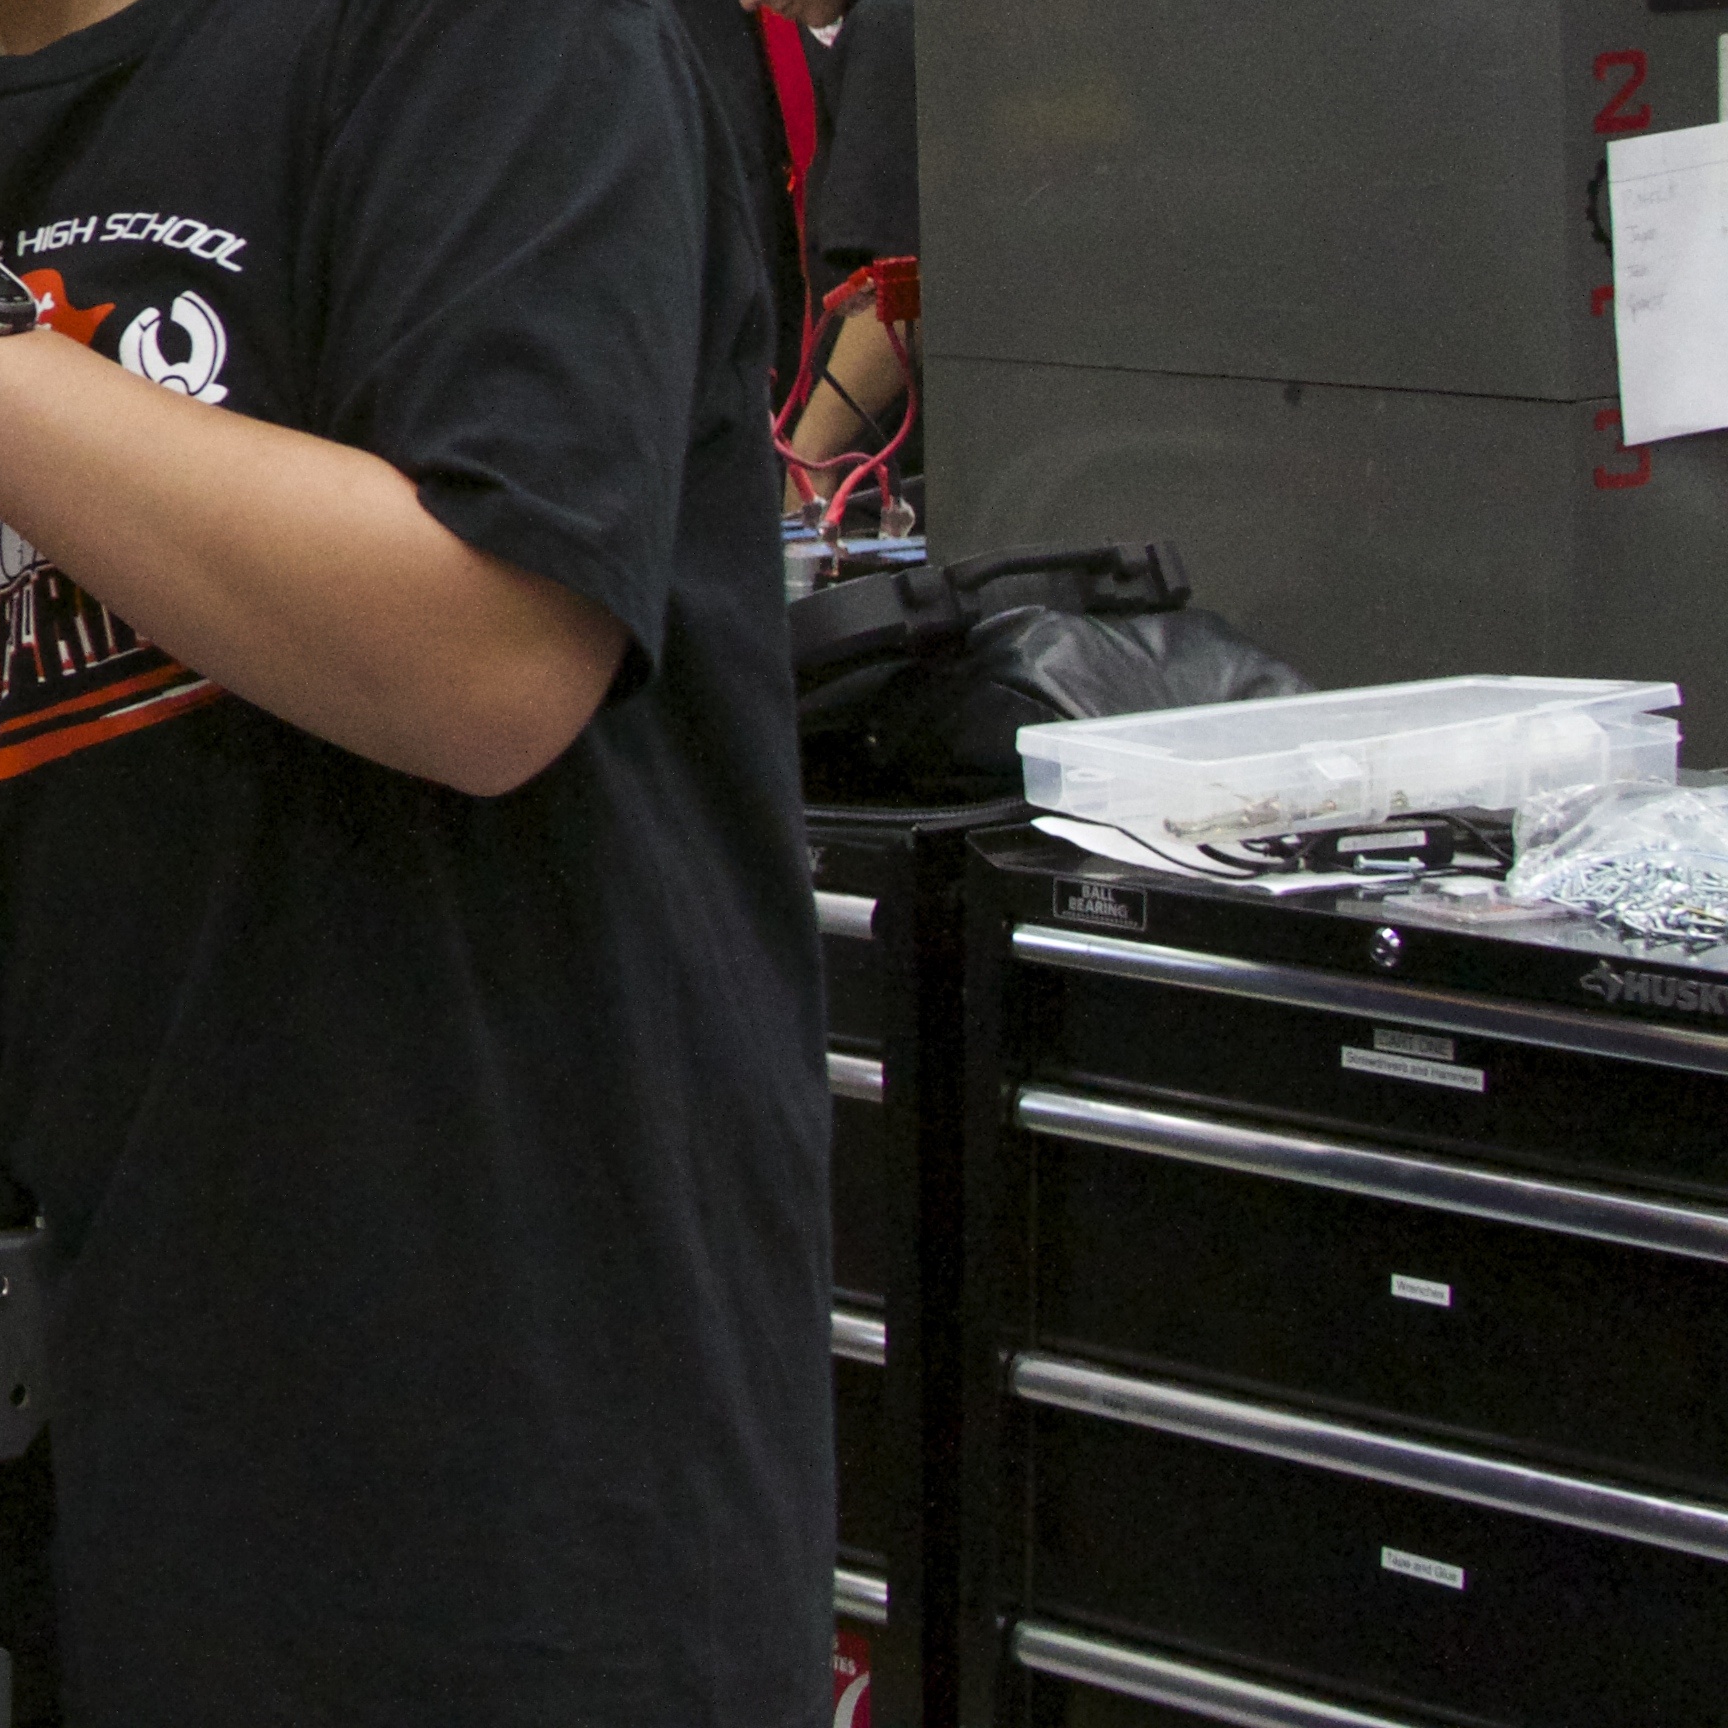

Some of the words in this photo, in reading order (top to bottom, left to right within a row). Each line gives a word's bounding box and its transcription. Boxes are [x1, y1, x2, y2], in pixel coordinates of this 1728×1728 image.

[1593, 49, 1653, 134] 2
[17, 216, 98, 257] HIGH
[100, 212, 247, 272] SCHOOL
[1065, 894, 1130, 919] BEARING
